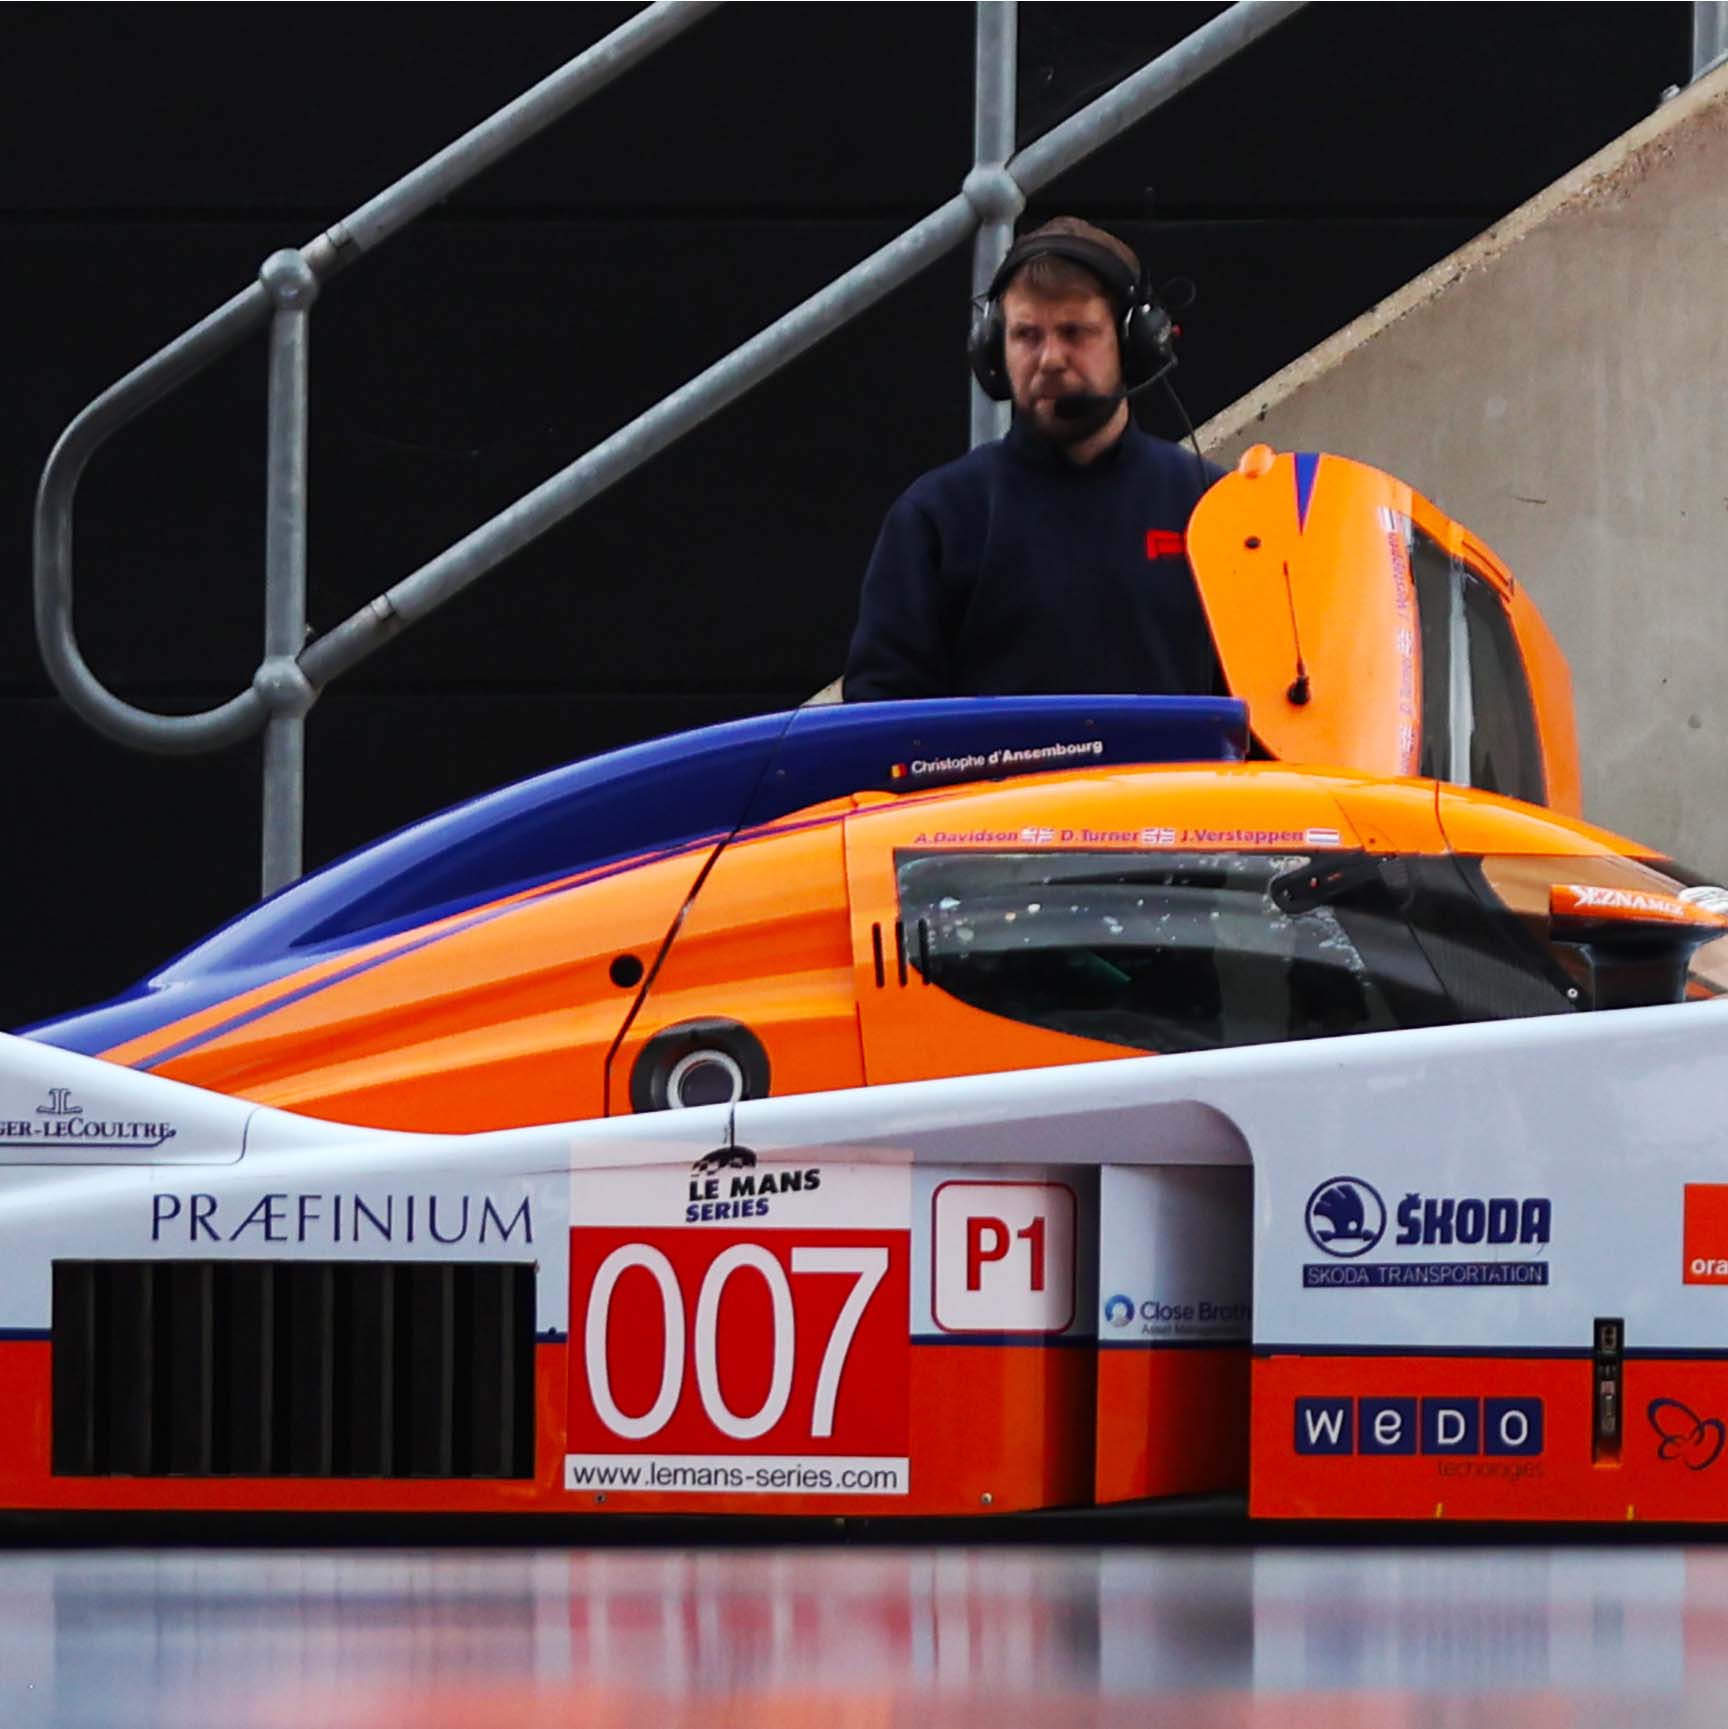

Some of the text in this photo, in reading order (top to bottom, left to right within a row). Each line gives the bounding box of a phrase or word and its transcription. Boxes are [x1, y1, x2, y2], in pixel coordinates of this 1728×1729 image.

[911, 740, 1103, 775] Christophe d'Ansembourg
[689, 1168, 821, 1202] LE MANS
[151, 1193, 534, 1244] PRÆFINIUM
[686, 1198, 770, 1223] SERIES
[1395, 1192, 1552, 1245] ŠKODA
[966, 1216, 1045, 1291] P1
[1379, 1264, 1543, 1283] TRANSPORTATION
[1140, 1301, 1194, 1321] Close
[584, 1242, 890, 1441] 007
[573, 1462, 898, 1489] www.lemans-series.com
